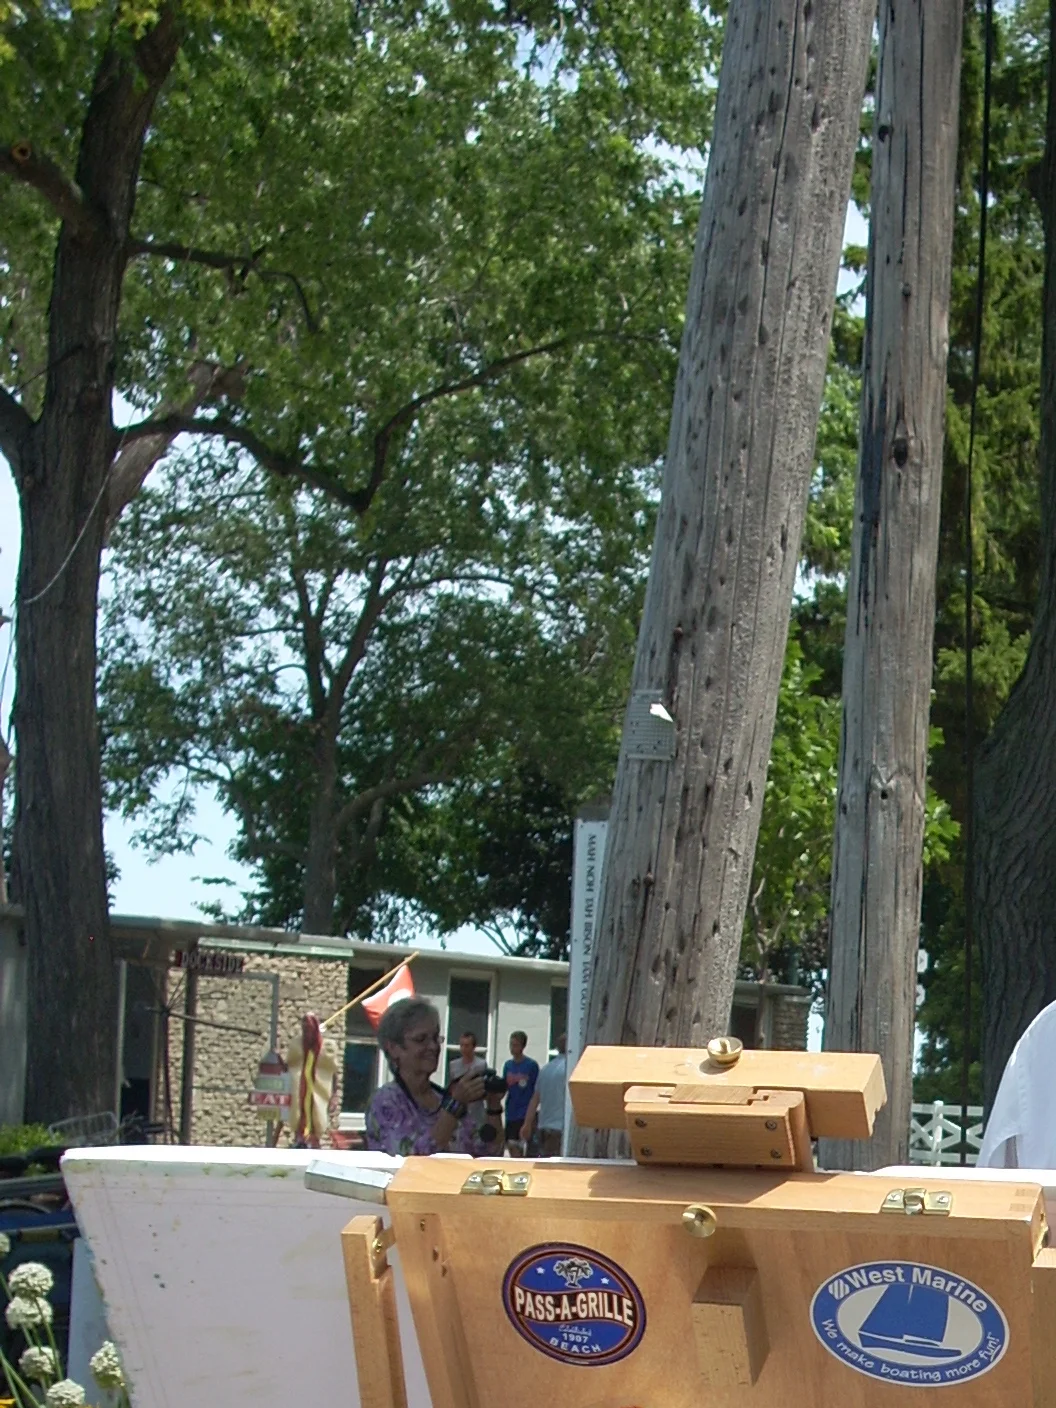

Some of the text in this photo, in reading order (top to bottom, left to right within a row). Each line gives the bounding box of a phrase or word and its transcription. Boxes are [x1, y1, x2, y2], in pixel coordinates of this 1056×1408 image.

[182, 951, 243, 973] DOCKSIDE
[513, 1286, 634, 1327] PASS-A-GRILLE
[844, 1266, 988, 1313] West Marine
[549, 1337, 602, 1354] BEACH
[821, 1318, 838, 1339] We
[836, 1342, 875, 1369] make
[880, 1363, 941, 1382] boating
[945, 1359, 981, 1379] more
